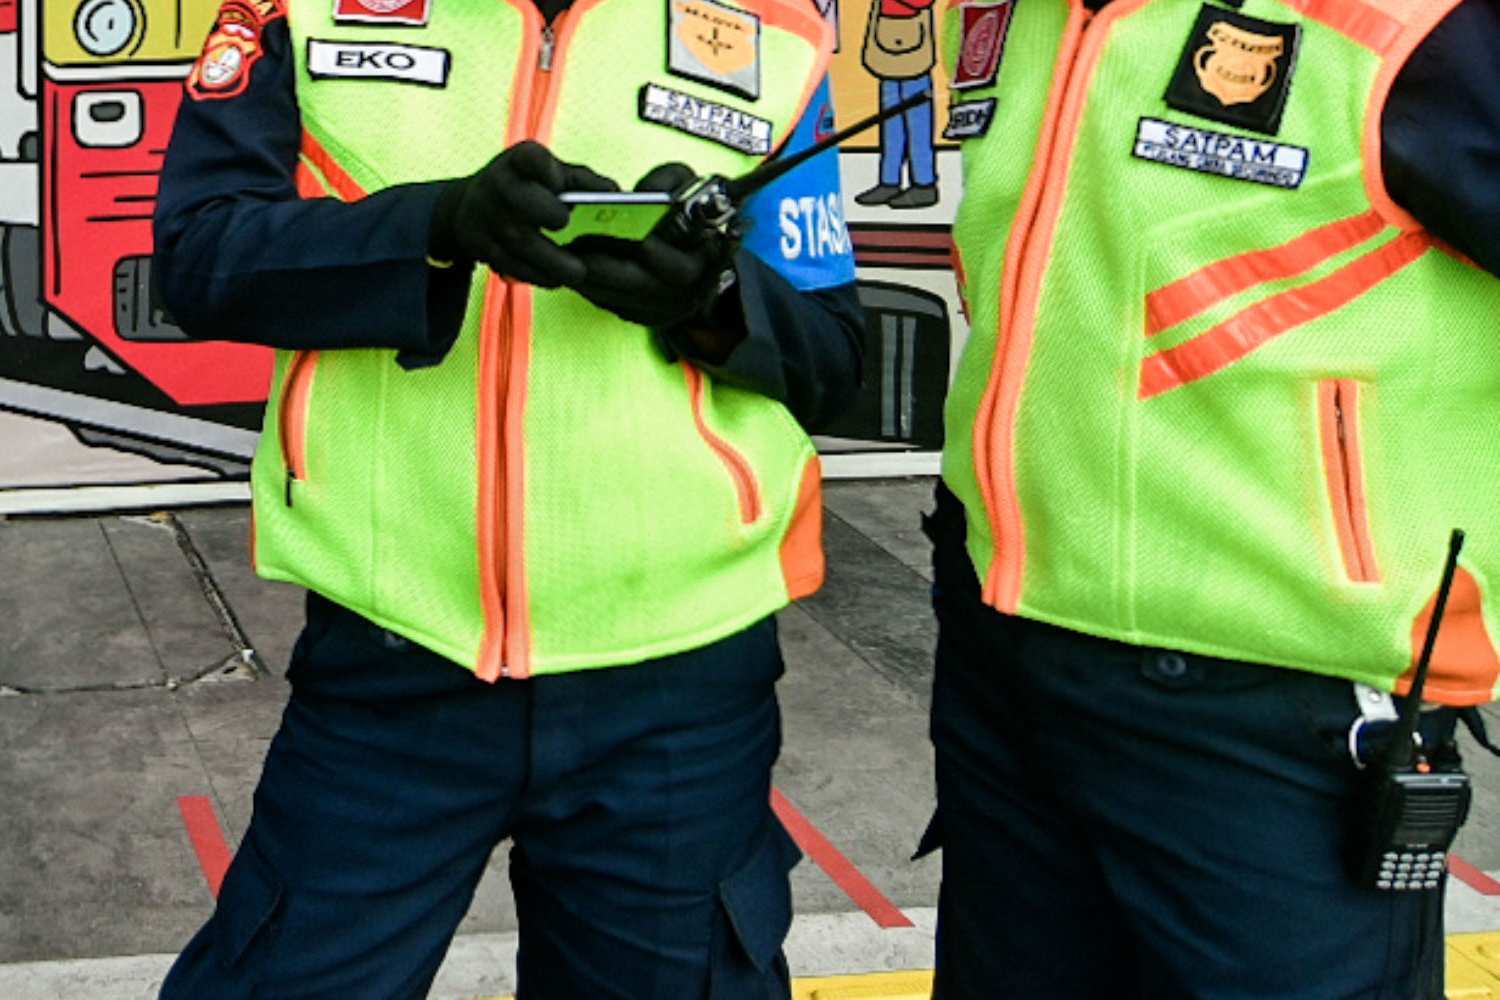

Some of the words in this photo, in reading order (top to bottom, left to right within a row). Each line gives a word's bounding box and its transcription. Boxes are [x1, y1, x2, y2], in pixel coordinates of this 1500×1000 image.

[335, 50, 416, 71] EKO
[668, 89, 755, 132] SATPAM
[1165, 126, 1277, 167] SATPAM
[779, 192, 851, 260] STAS
